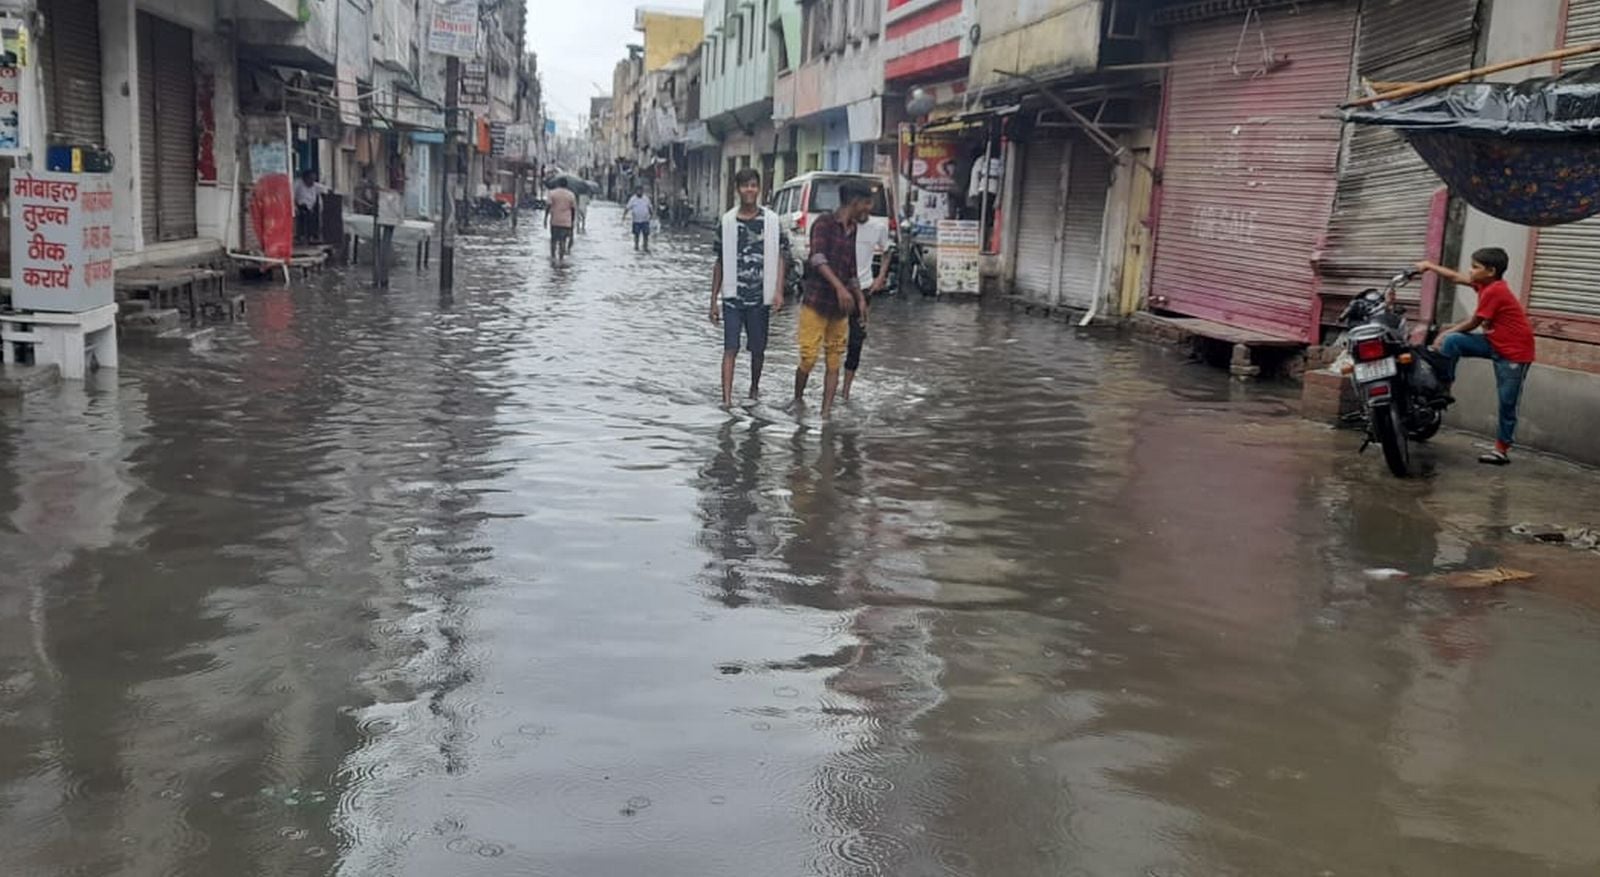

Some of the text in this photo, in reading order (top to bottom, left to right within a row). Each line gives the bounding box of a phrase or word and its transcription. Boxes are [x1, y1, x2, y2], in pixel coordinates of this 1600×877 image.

[14, 173, 78, 201] मोबाइल
[23, 204, 68, 231] तुरन्त
[27, 233, 67, 261] ठीक
[23, 265, 72, 289] करायें
